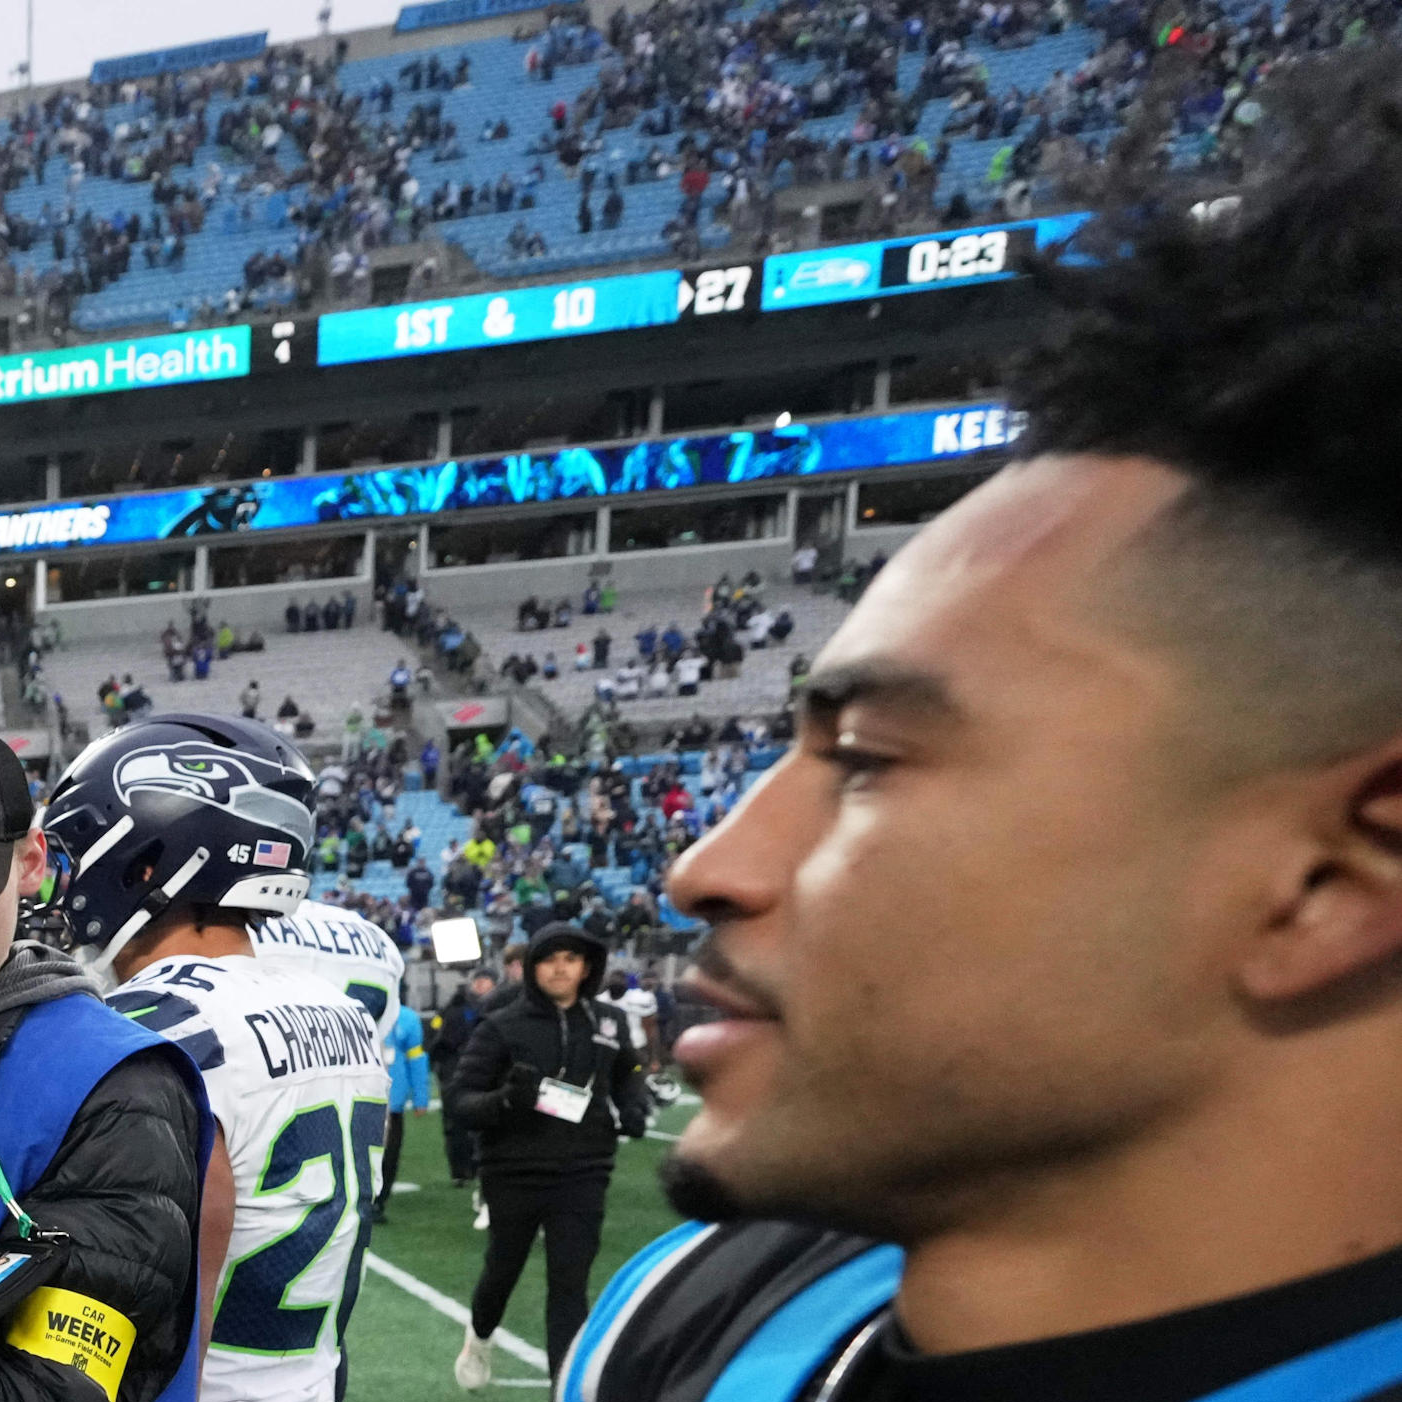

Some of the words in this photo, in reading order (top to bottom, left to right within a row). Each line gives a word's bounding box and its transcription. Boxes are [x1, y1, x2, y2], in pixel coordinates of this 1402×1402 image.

[907, 231, 1008, 284] 0:23
[693, 267, 752, 316] 27
[395, 307, 453, 350] 1ST
[483, 298, 515, 339] &
[552, 288, 595, 332] 10
[104, 335, 238, 386] Health
[226, 843, 252, 864] 45
[47, 1310, 107, 1350] WEEK
[105, 1335, 122, 1358] 17
[82, 1305, 106, 1324] CAR
[45, 1332, 77, 1348] In-Game
[77, 1342, 93, 1356] Field
[93, 1351, 113, 1369] Access
